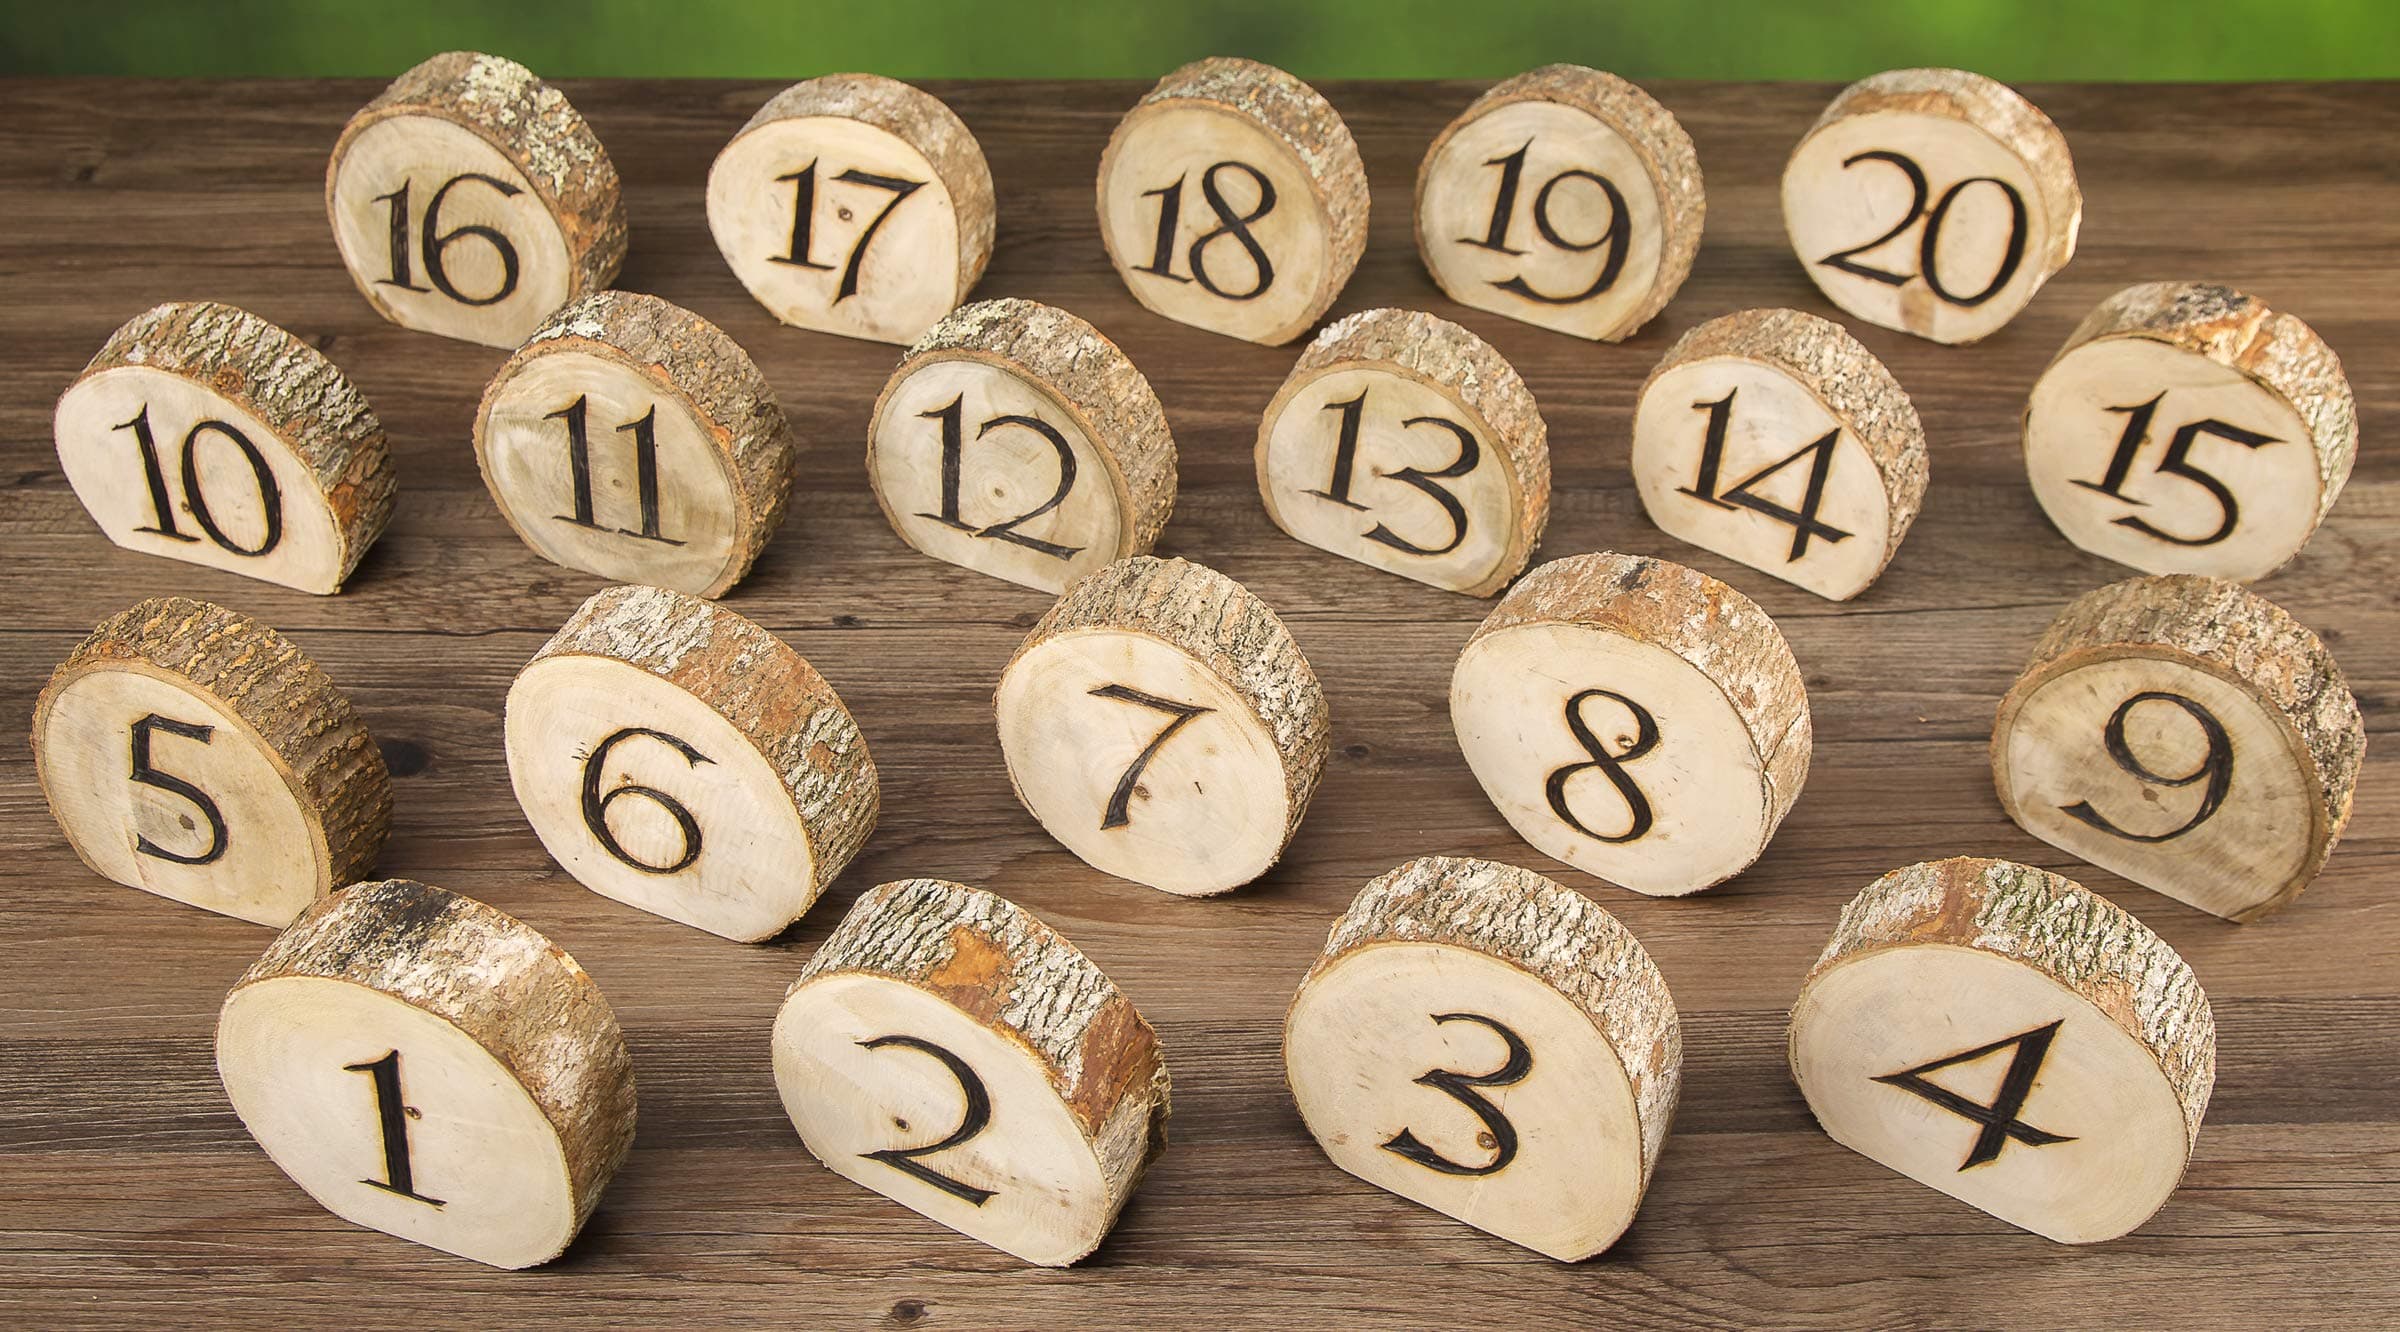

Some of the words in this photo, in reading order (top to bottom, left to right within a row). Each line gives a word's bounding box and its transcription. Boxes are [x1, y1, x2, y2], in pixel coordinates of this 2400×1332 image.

[372, 173, 524, 307] 16
[768, 157, 927, 305] 17
[1132, 161, 1277, 301] 18
[1456, 137, 1632, 305] 19
[1818, 150, 2028, 308] 20
[111, 403, 283, 557] 10
[542, 394, 688, 547] 11
[914, 392, 1086, 561] 12
[1300, 384, 1480, 556] 13
[1676, 385, 1854, 563] 14
[2068, 389, 2288, 547] 15
[128, 712, 229, 866] 5
[581, 727, 717, 875] 6
[1086, 684, 1217, 831] 7
[1545, 688, 1661, 844] 8
[2058, 691, 2235, 844] 9
[343, 1049, 447, 1207] 1
[854, 1035, 1000, 1209] 2
[1380, 1013, 1532, 1177] 3
[1869, 1018, 2079, 1172] 4
